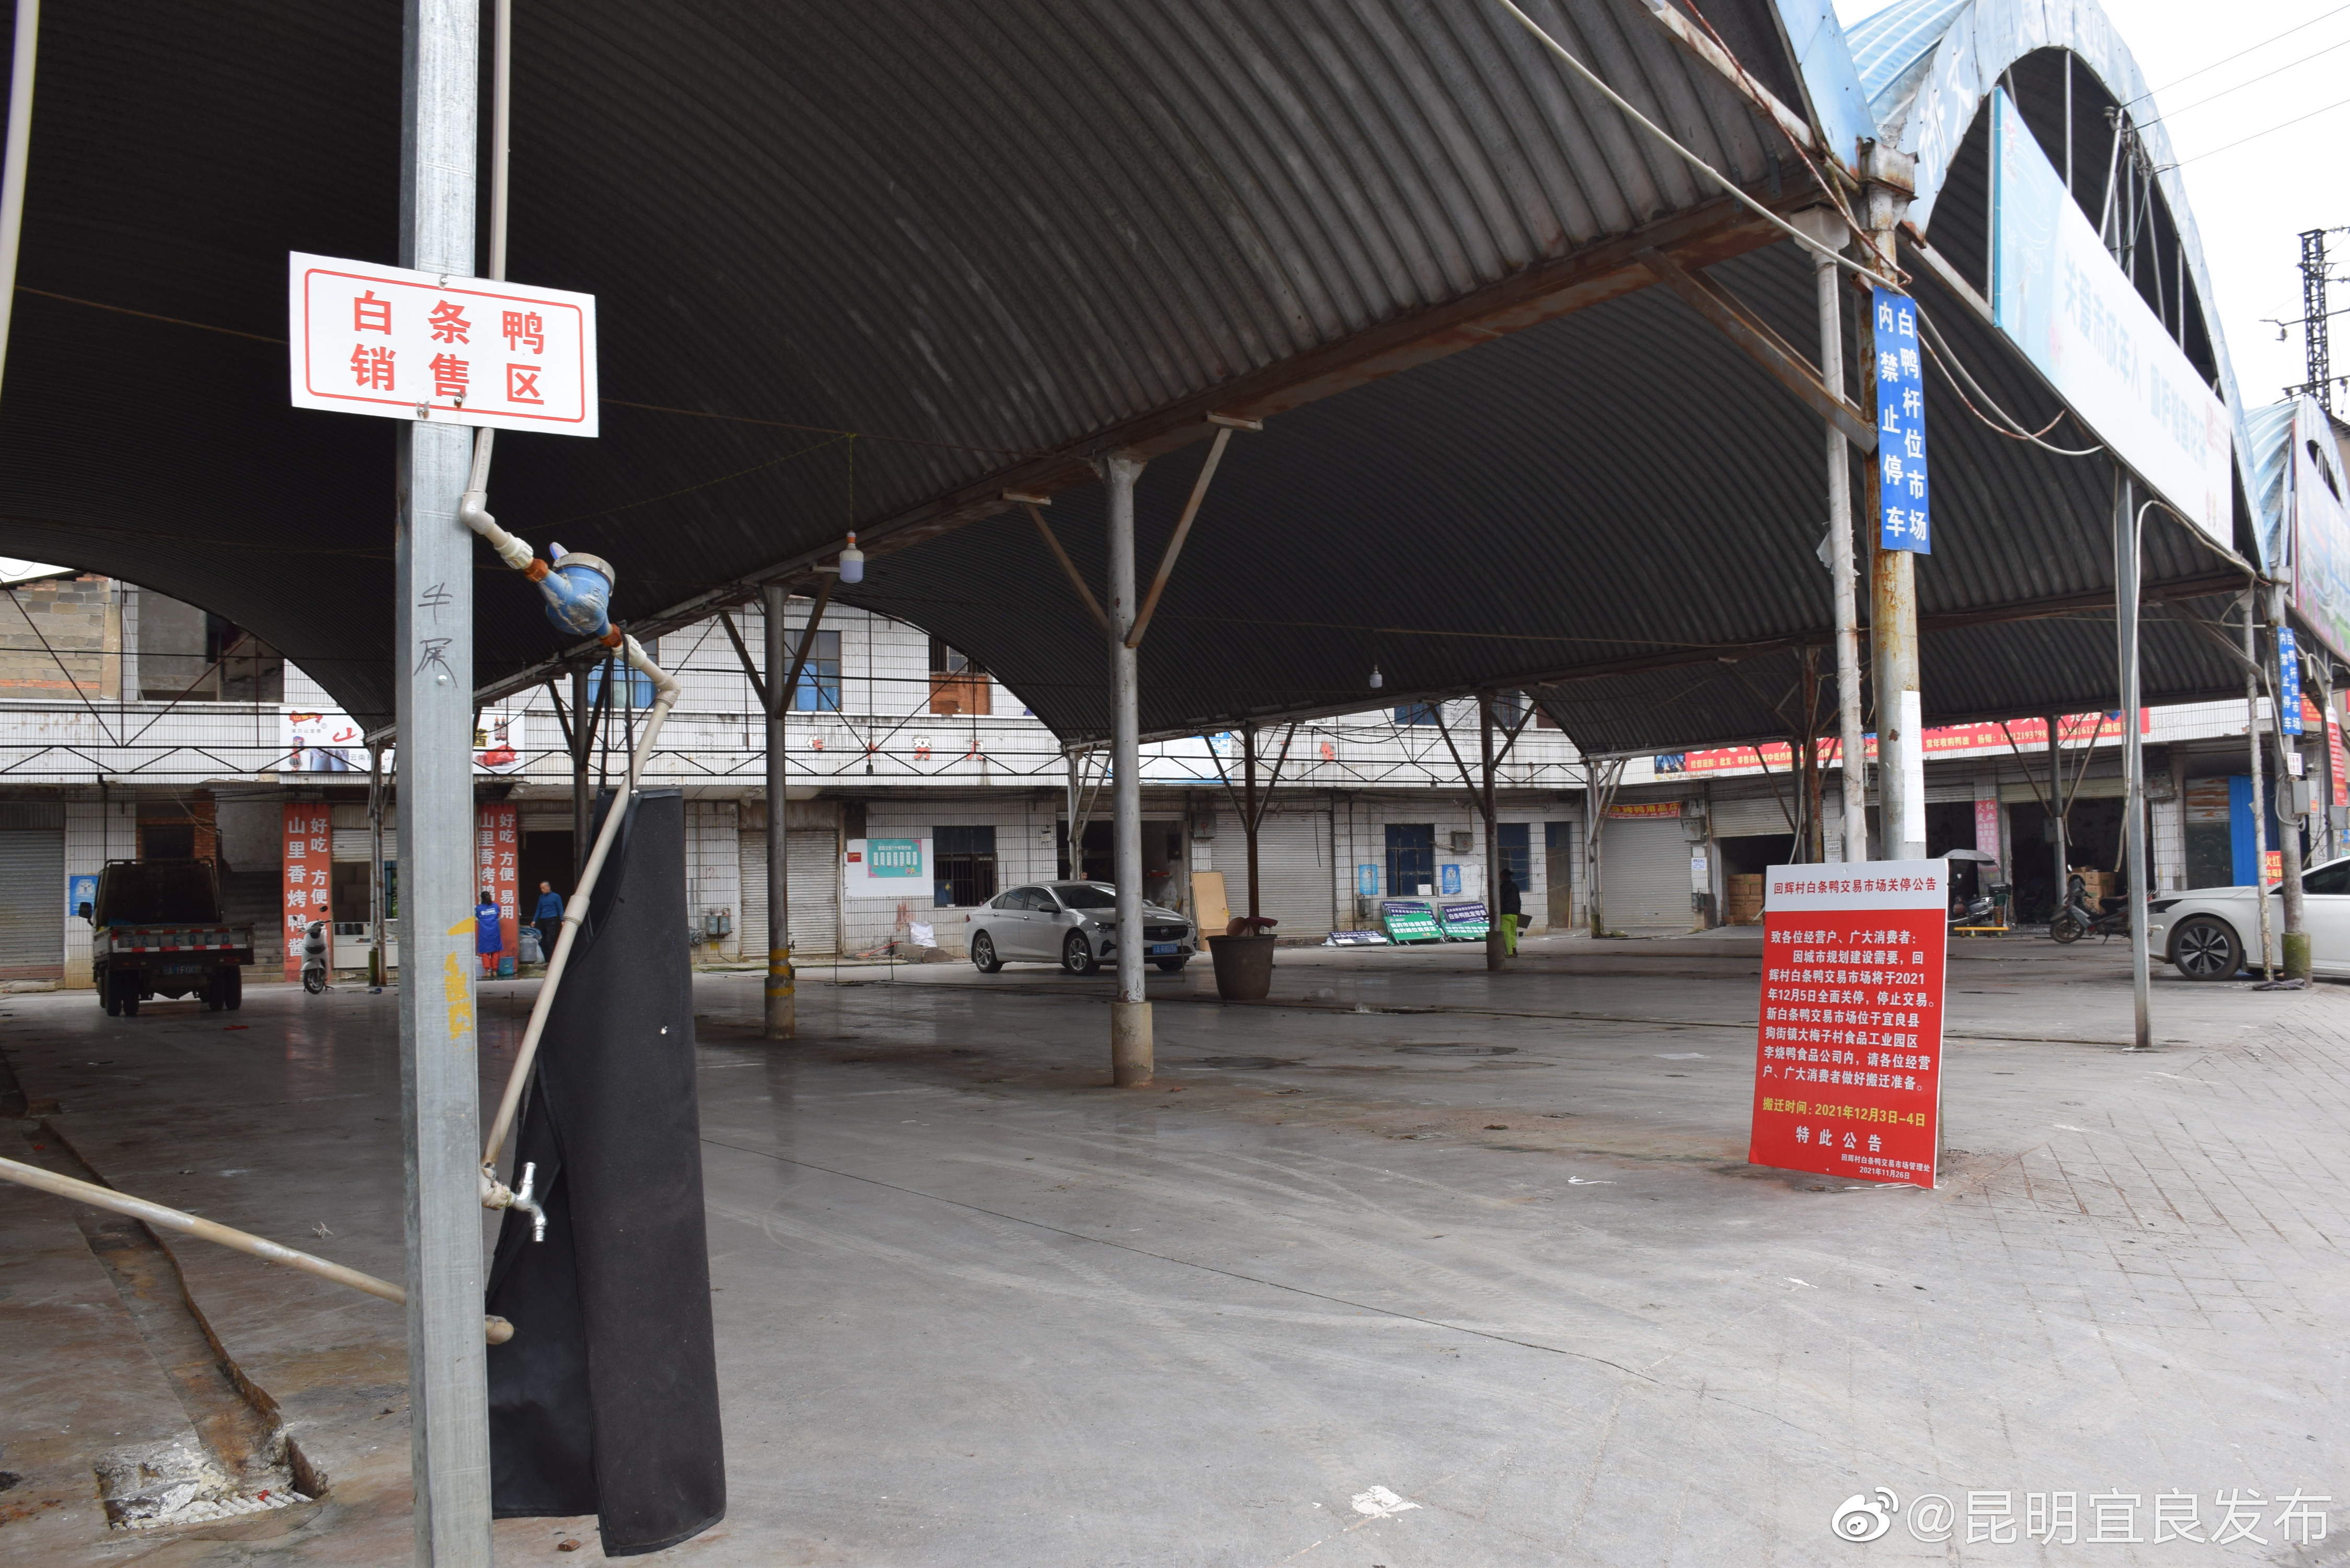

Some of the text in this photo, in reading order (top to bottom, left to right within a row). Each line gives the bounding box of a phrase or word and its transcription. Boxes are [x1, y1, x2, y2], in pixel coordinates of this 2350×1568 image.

[353, 290, 545, 354] 白条鸭
[350, 343, 545, 405] 销售区
[1879, 301, 1906, 537] 内禁止停车
[1898, 307, 1927, 541] 白鸭杆位市场
[1926, 735, 1969, 748] 常年收购鸭油
[310, 818, 328, 905] 好吃 方便
[499, 814, 515, 920] 好吃 方便 易用
[287, 817, 307, 957] 山里香烤鸭酱
[1773, 877, 1937, 895] 回辉村白条鸭交易市场关停公告
[1771, 929, 1917, 944] 致各位经营户、广大消费者：
[1793, 949, 1923, 965] 因城市规划建设需要，回
[1769, 969, 1925, 986] 辉村白条鸭交易市场将于2021
[1768, 988, 1934, 1008] 年12月5日全面关停，停止交易。
[1766, 1007, 1919, 1028] 新白条鸭交易市场位于宜良县
[1765, 1025, 1918, 1048] 狗街镇大梅子村食品工业园区
[1764, 1045, 1931, 1071] 李烧鸭食品公司内，请各位经营
[1762, 1065, 1922, 1091] 户、广大消费者做好搬迁准备。
[1796, 1126, 1882, 1153] 特此公告
[1841, 1153, 1931, 1173] 回辉村白条鸭交易市场管理处
[1859, 1166, 1910, 1180] 2021年11月26日
